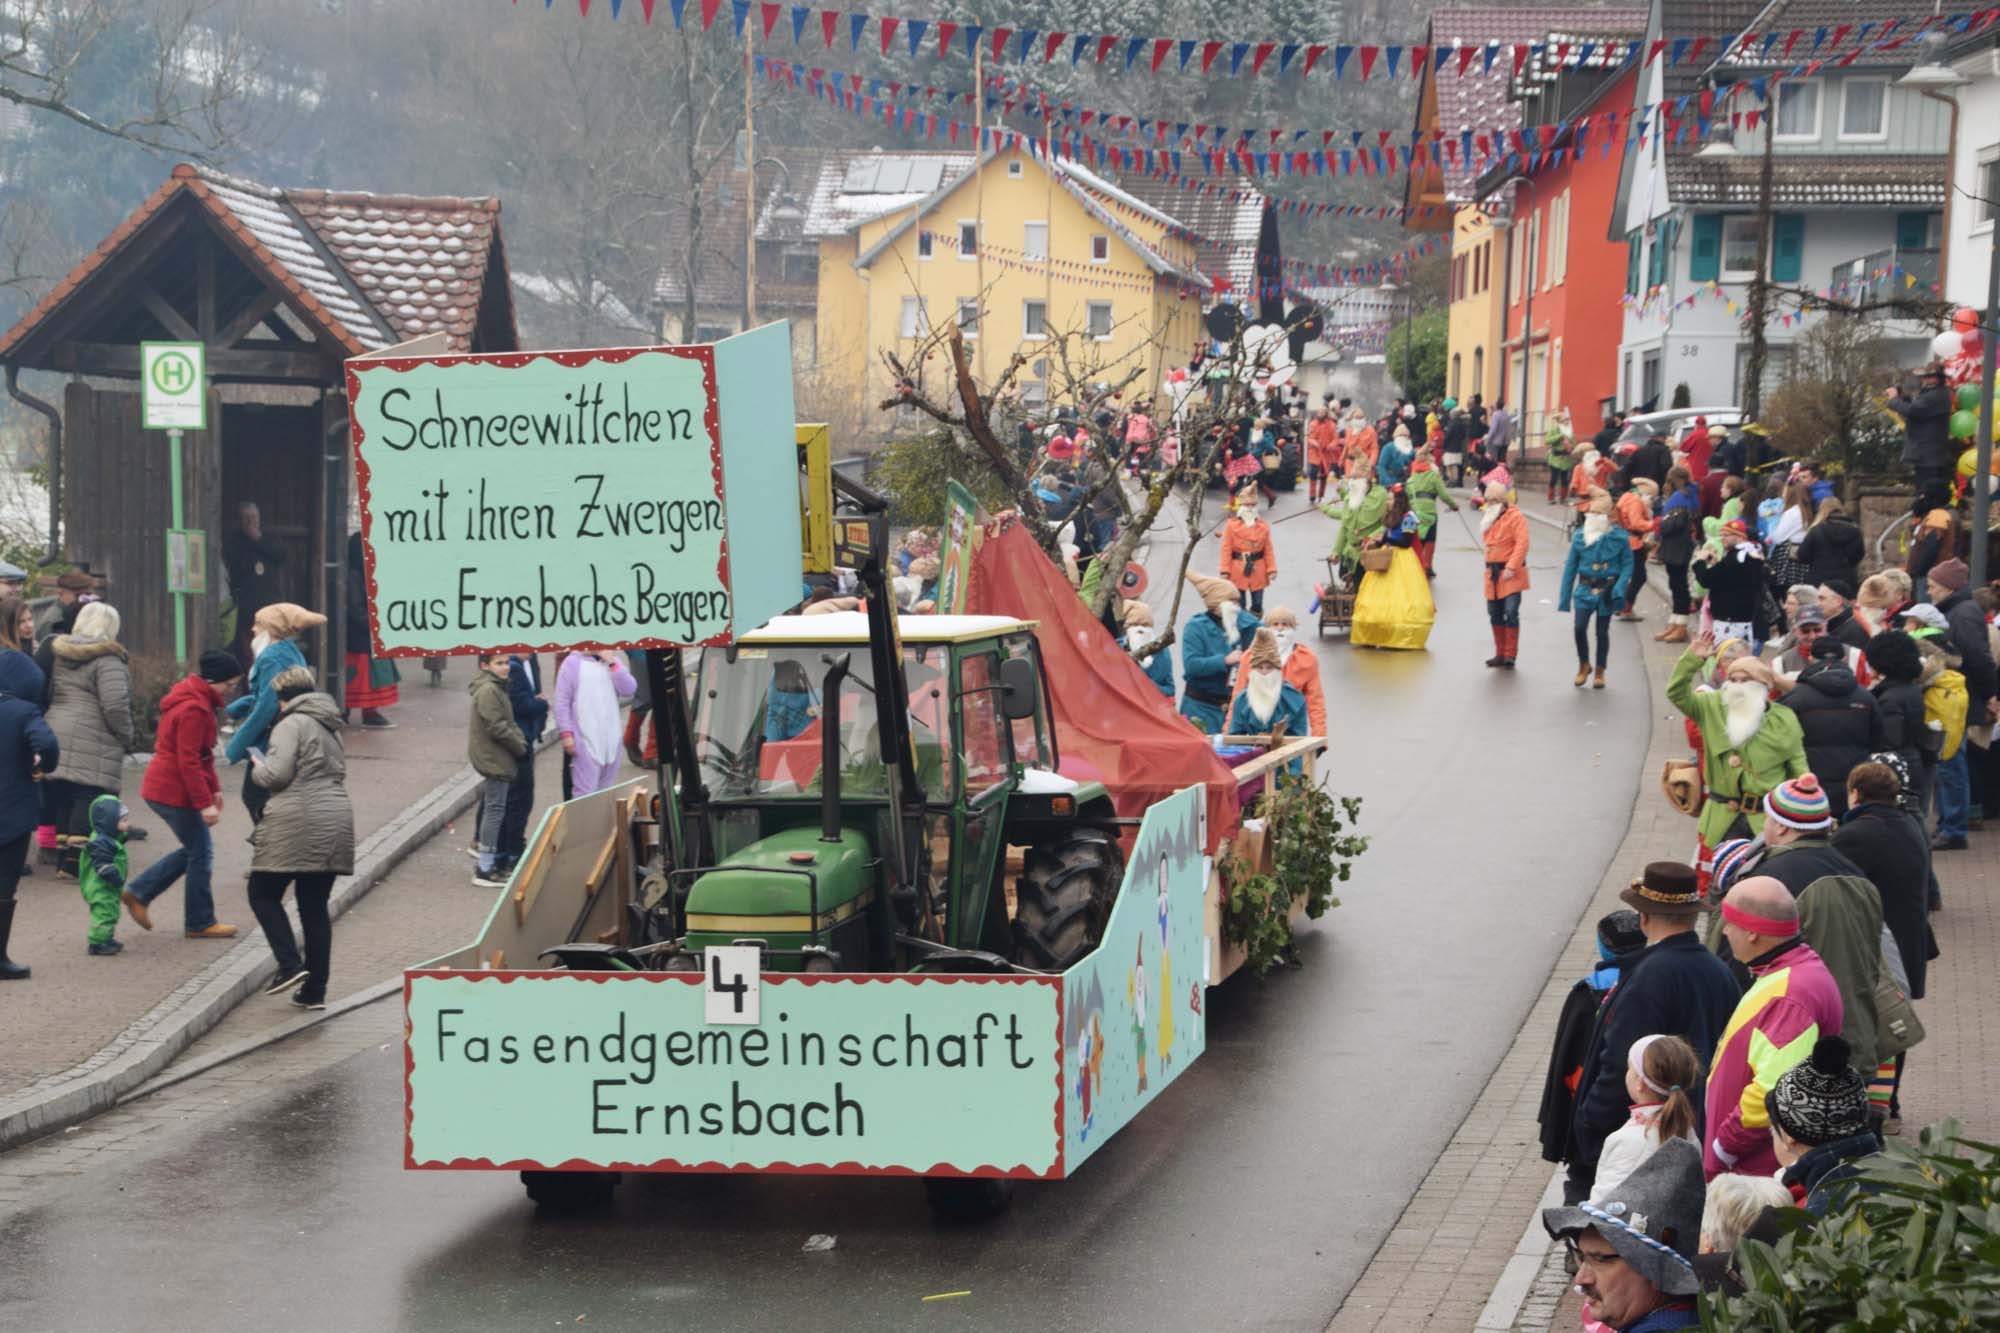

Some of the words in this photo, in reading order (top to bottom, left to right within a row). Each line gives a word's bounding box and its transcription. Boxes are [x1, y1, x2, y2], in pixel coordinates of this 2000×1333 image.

[163, 361, 184, 386] H
[1681, 344, 1699, 357] 38
[380, 382, 693, 451] Schneewittchen
[383, 479, 449, 543] mit
[465, 478, 556, 541] ihren
[574, 474, 724, 553] Zwergen
[387, 599, 448, 632] aus
[458, 563, 628, 630] Ernsbachs
[631, 562, 729, 643] Bergen
[711, 954, 749, 1013] 4
[438, 1008, 1034, 1085] Fasendgemeinschaft
[592, 1079, 864, 1137] Ernsbach
